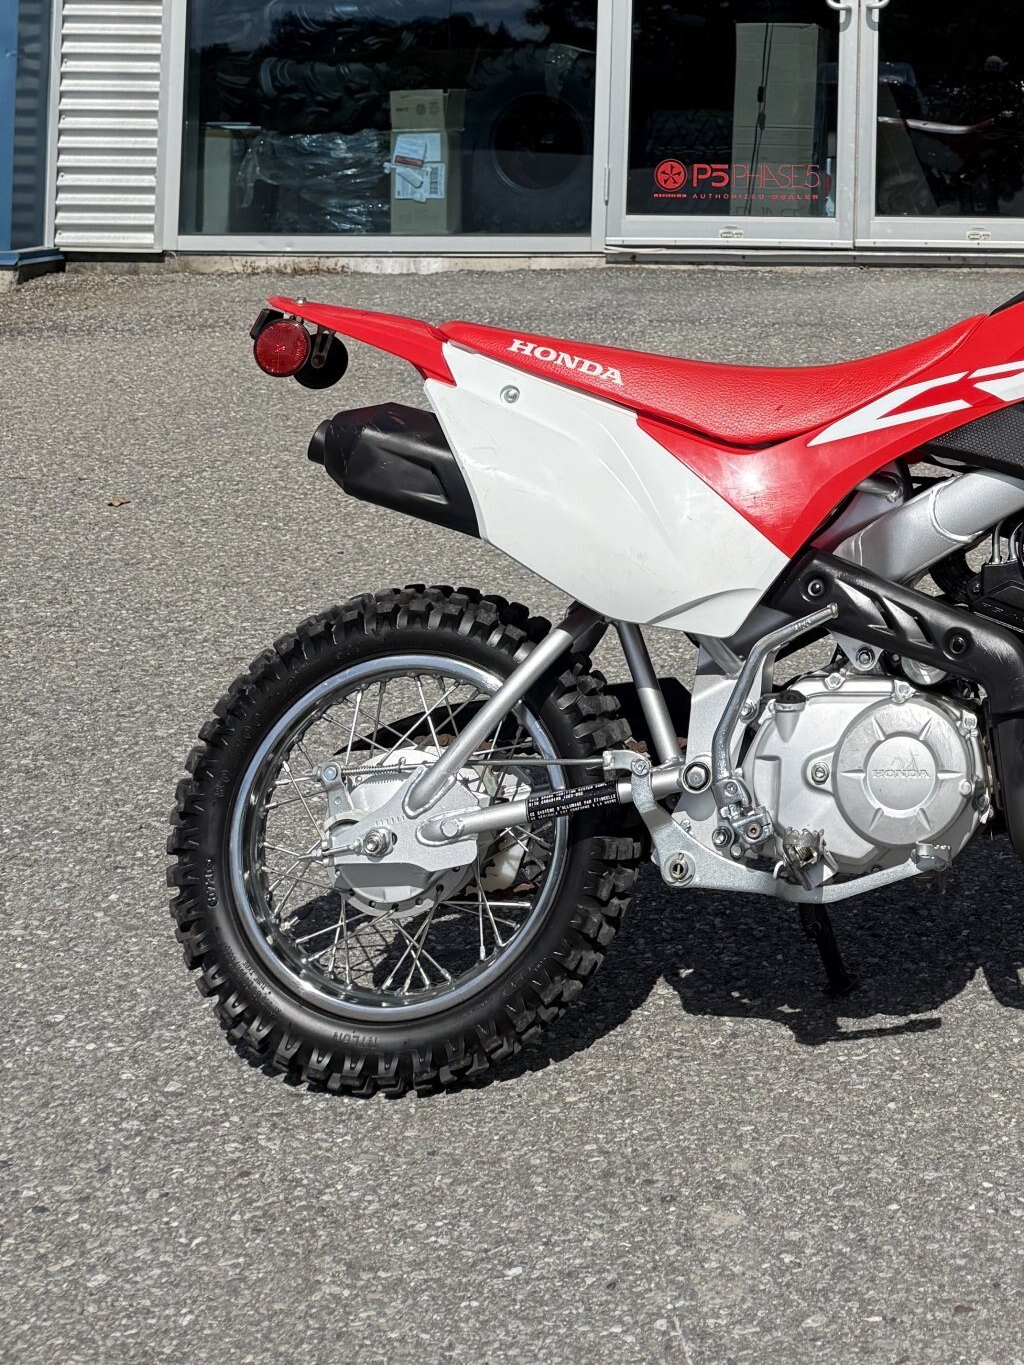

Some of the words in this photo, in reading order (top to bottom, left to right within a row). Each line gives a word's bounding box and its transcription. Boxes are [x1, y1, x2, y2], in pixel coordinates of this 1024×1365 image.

[692, 163, 730, 189] P5
[692, 193, 765, 201] AUTHORIZED
[770, 193, 820, 201] DEALER
[507, 338, 624, 386] HONDA
[871, 769, 932, 779] HONDA
